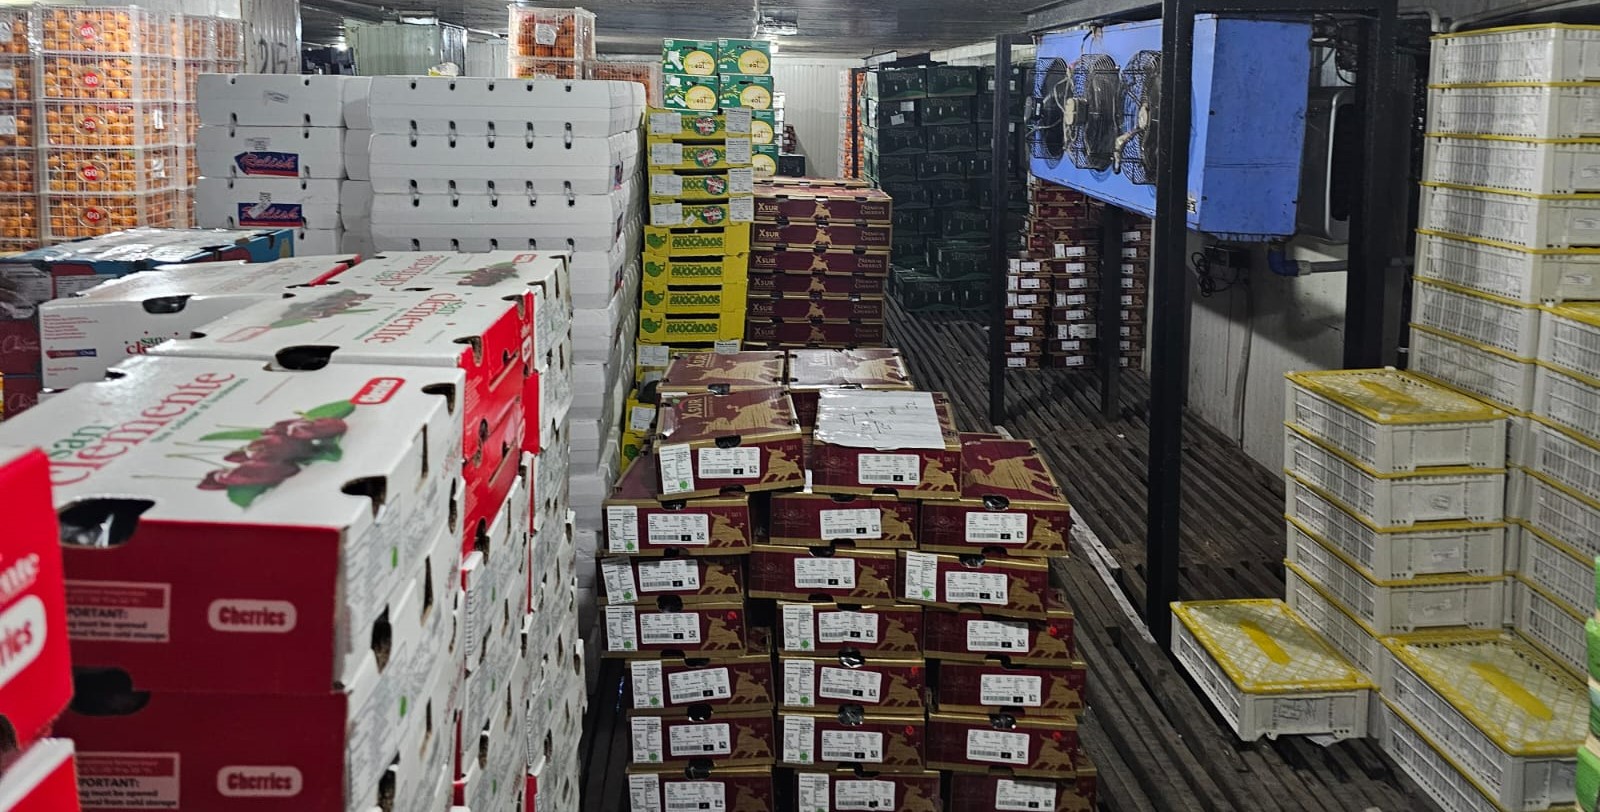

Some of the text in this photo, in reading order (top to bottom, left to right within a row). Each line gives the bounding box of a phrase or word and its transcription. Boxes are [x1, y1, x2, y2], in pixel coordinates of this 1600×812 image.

[81, 27, 95, 38] 60
[85, 75, 98, 85] 60
[84, 167, 97, 177] 60
[87, 211, 100, 221] 60
[672, 237, 723, 248] AVOCADOS
[671, 266, 722, 276] AVOCADOS
[669, 295, 720, 305] AVOCADOS
[666, 323, 718, 333] AVOCADOS
[49, 372, 236, 487] clemente
[50, 424, 118, 459] san
[219, 606, 286, 626] Cherries
[79, 777, 140, 788] PORTANT:
[227, 772, 292, 791] Cherries
